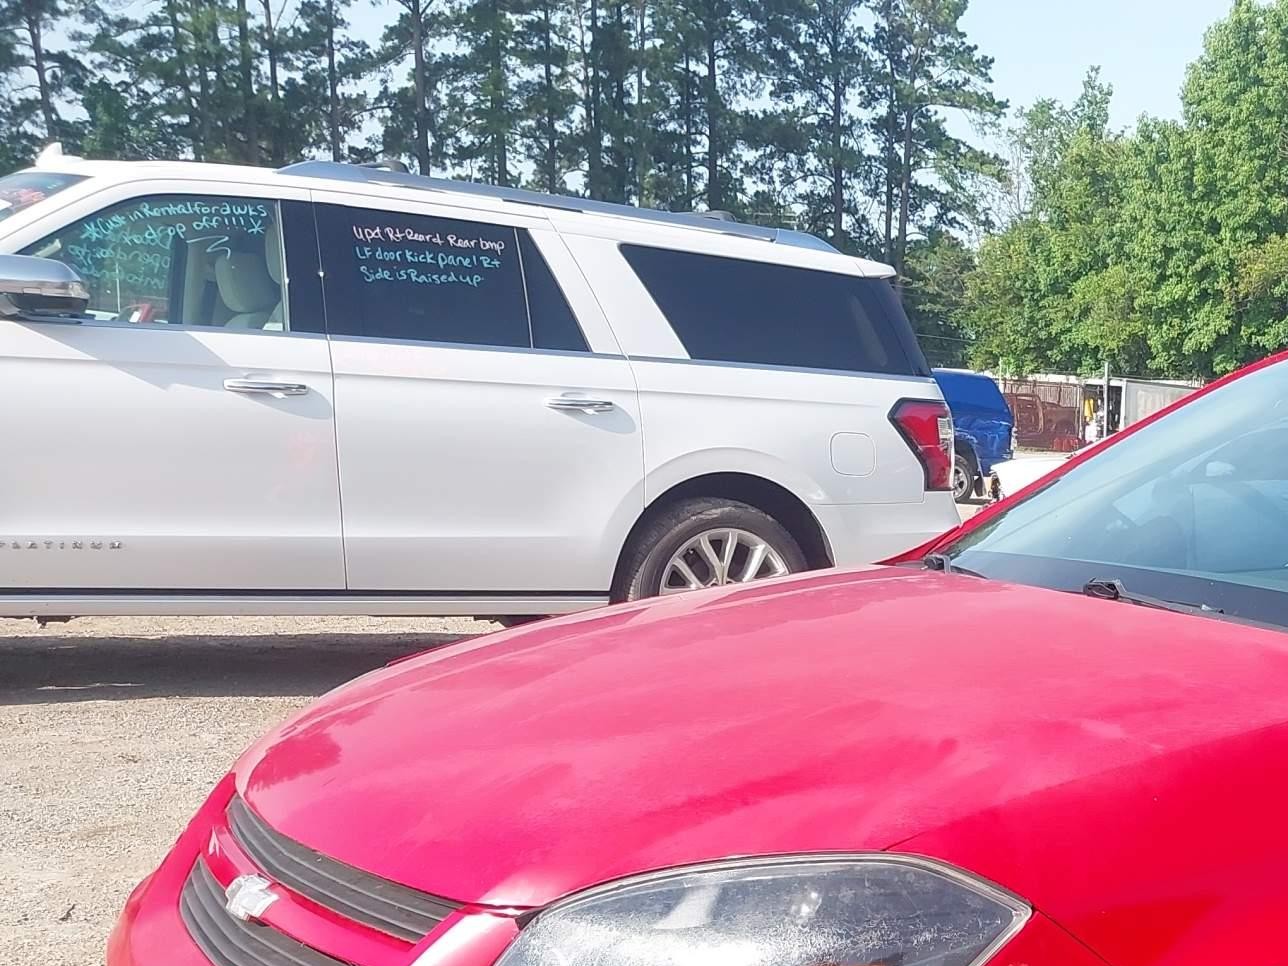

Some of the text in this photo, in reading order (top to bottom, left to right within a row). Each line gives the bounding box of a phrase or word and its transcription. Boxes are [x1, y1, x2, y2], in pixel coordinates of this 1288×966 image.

[446, 234, 478, 249] Rear
[375, 247, 402, 262] door
[360, 265, 394, 282] Side
